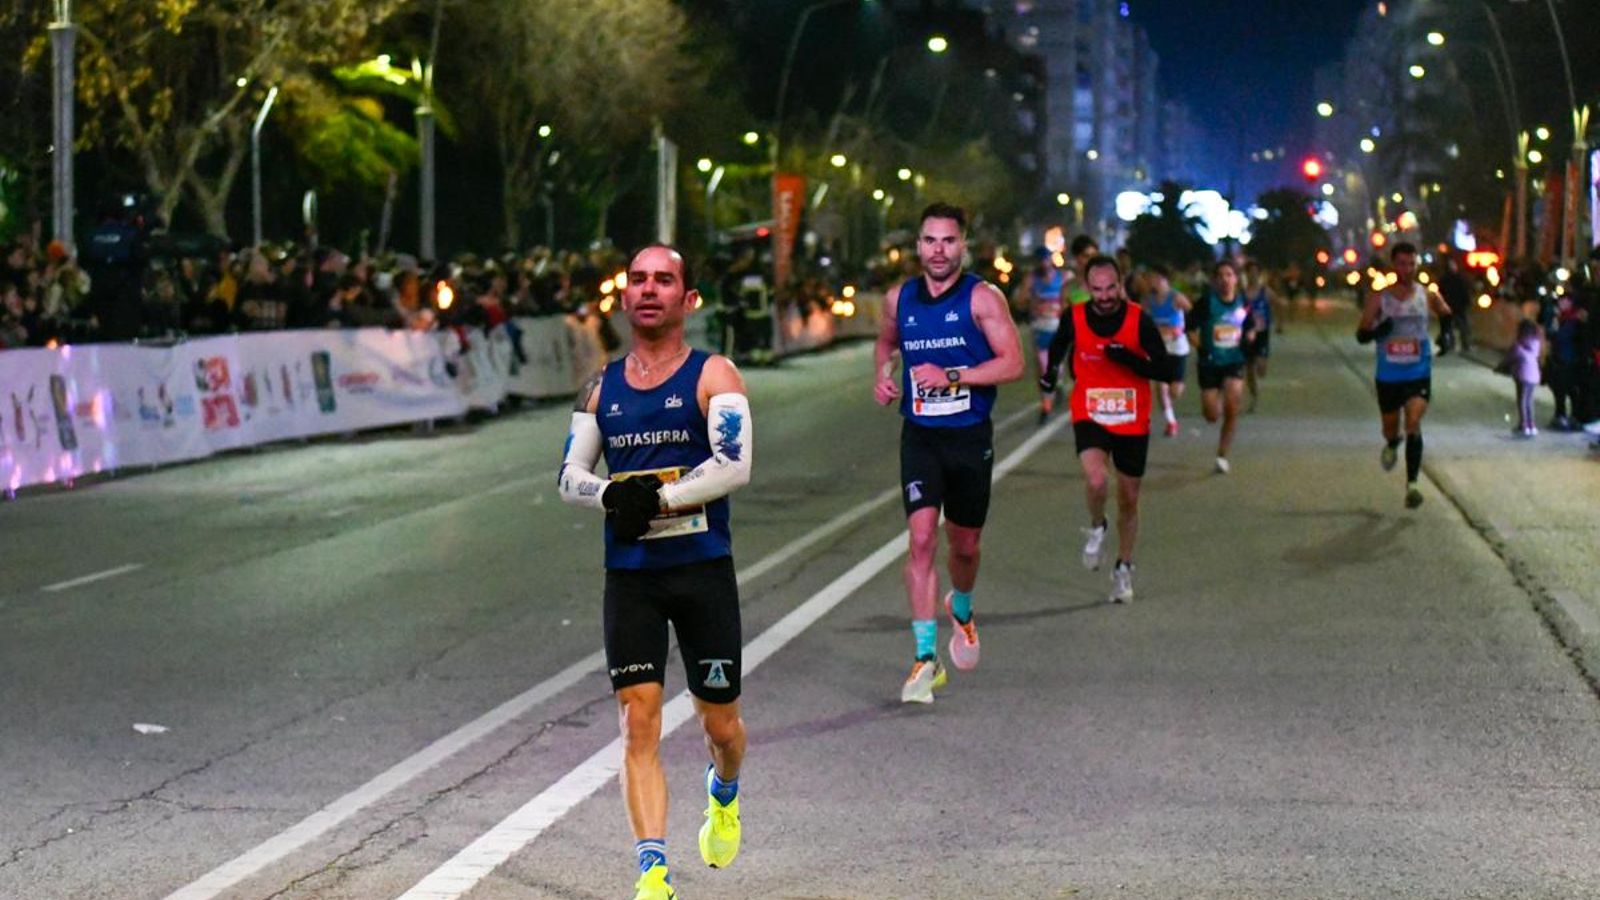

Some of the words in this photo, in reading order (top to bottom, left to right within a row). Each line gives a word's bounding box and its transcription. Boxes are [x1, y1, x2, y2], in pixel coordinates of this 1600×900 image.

[904, 336, 967, 351] TROTASIERRA
[1096, 398, 1127, 412] 282
[608, 429, 690, 449] TROTASIERRA
